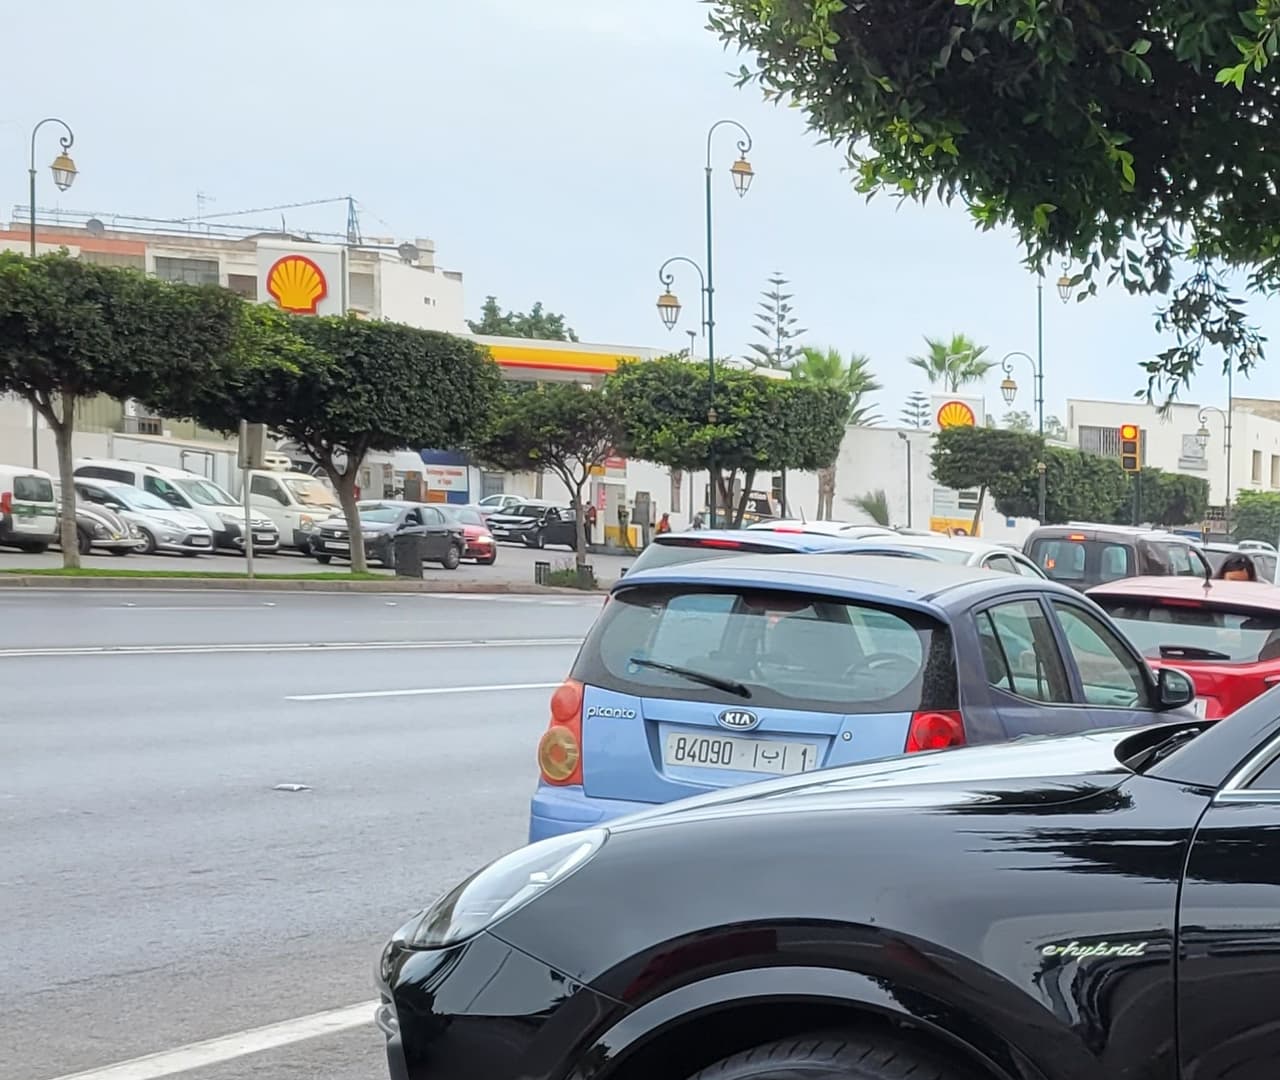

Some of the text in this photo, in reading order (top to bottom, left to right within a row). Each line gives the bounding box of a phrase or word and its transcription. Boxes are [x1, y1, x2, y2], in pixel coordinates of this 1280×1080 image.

[586, 705, 637, 720] picanto
[724, 712, 751, 725] KIA
[674, 737, 733, 766] 84090
